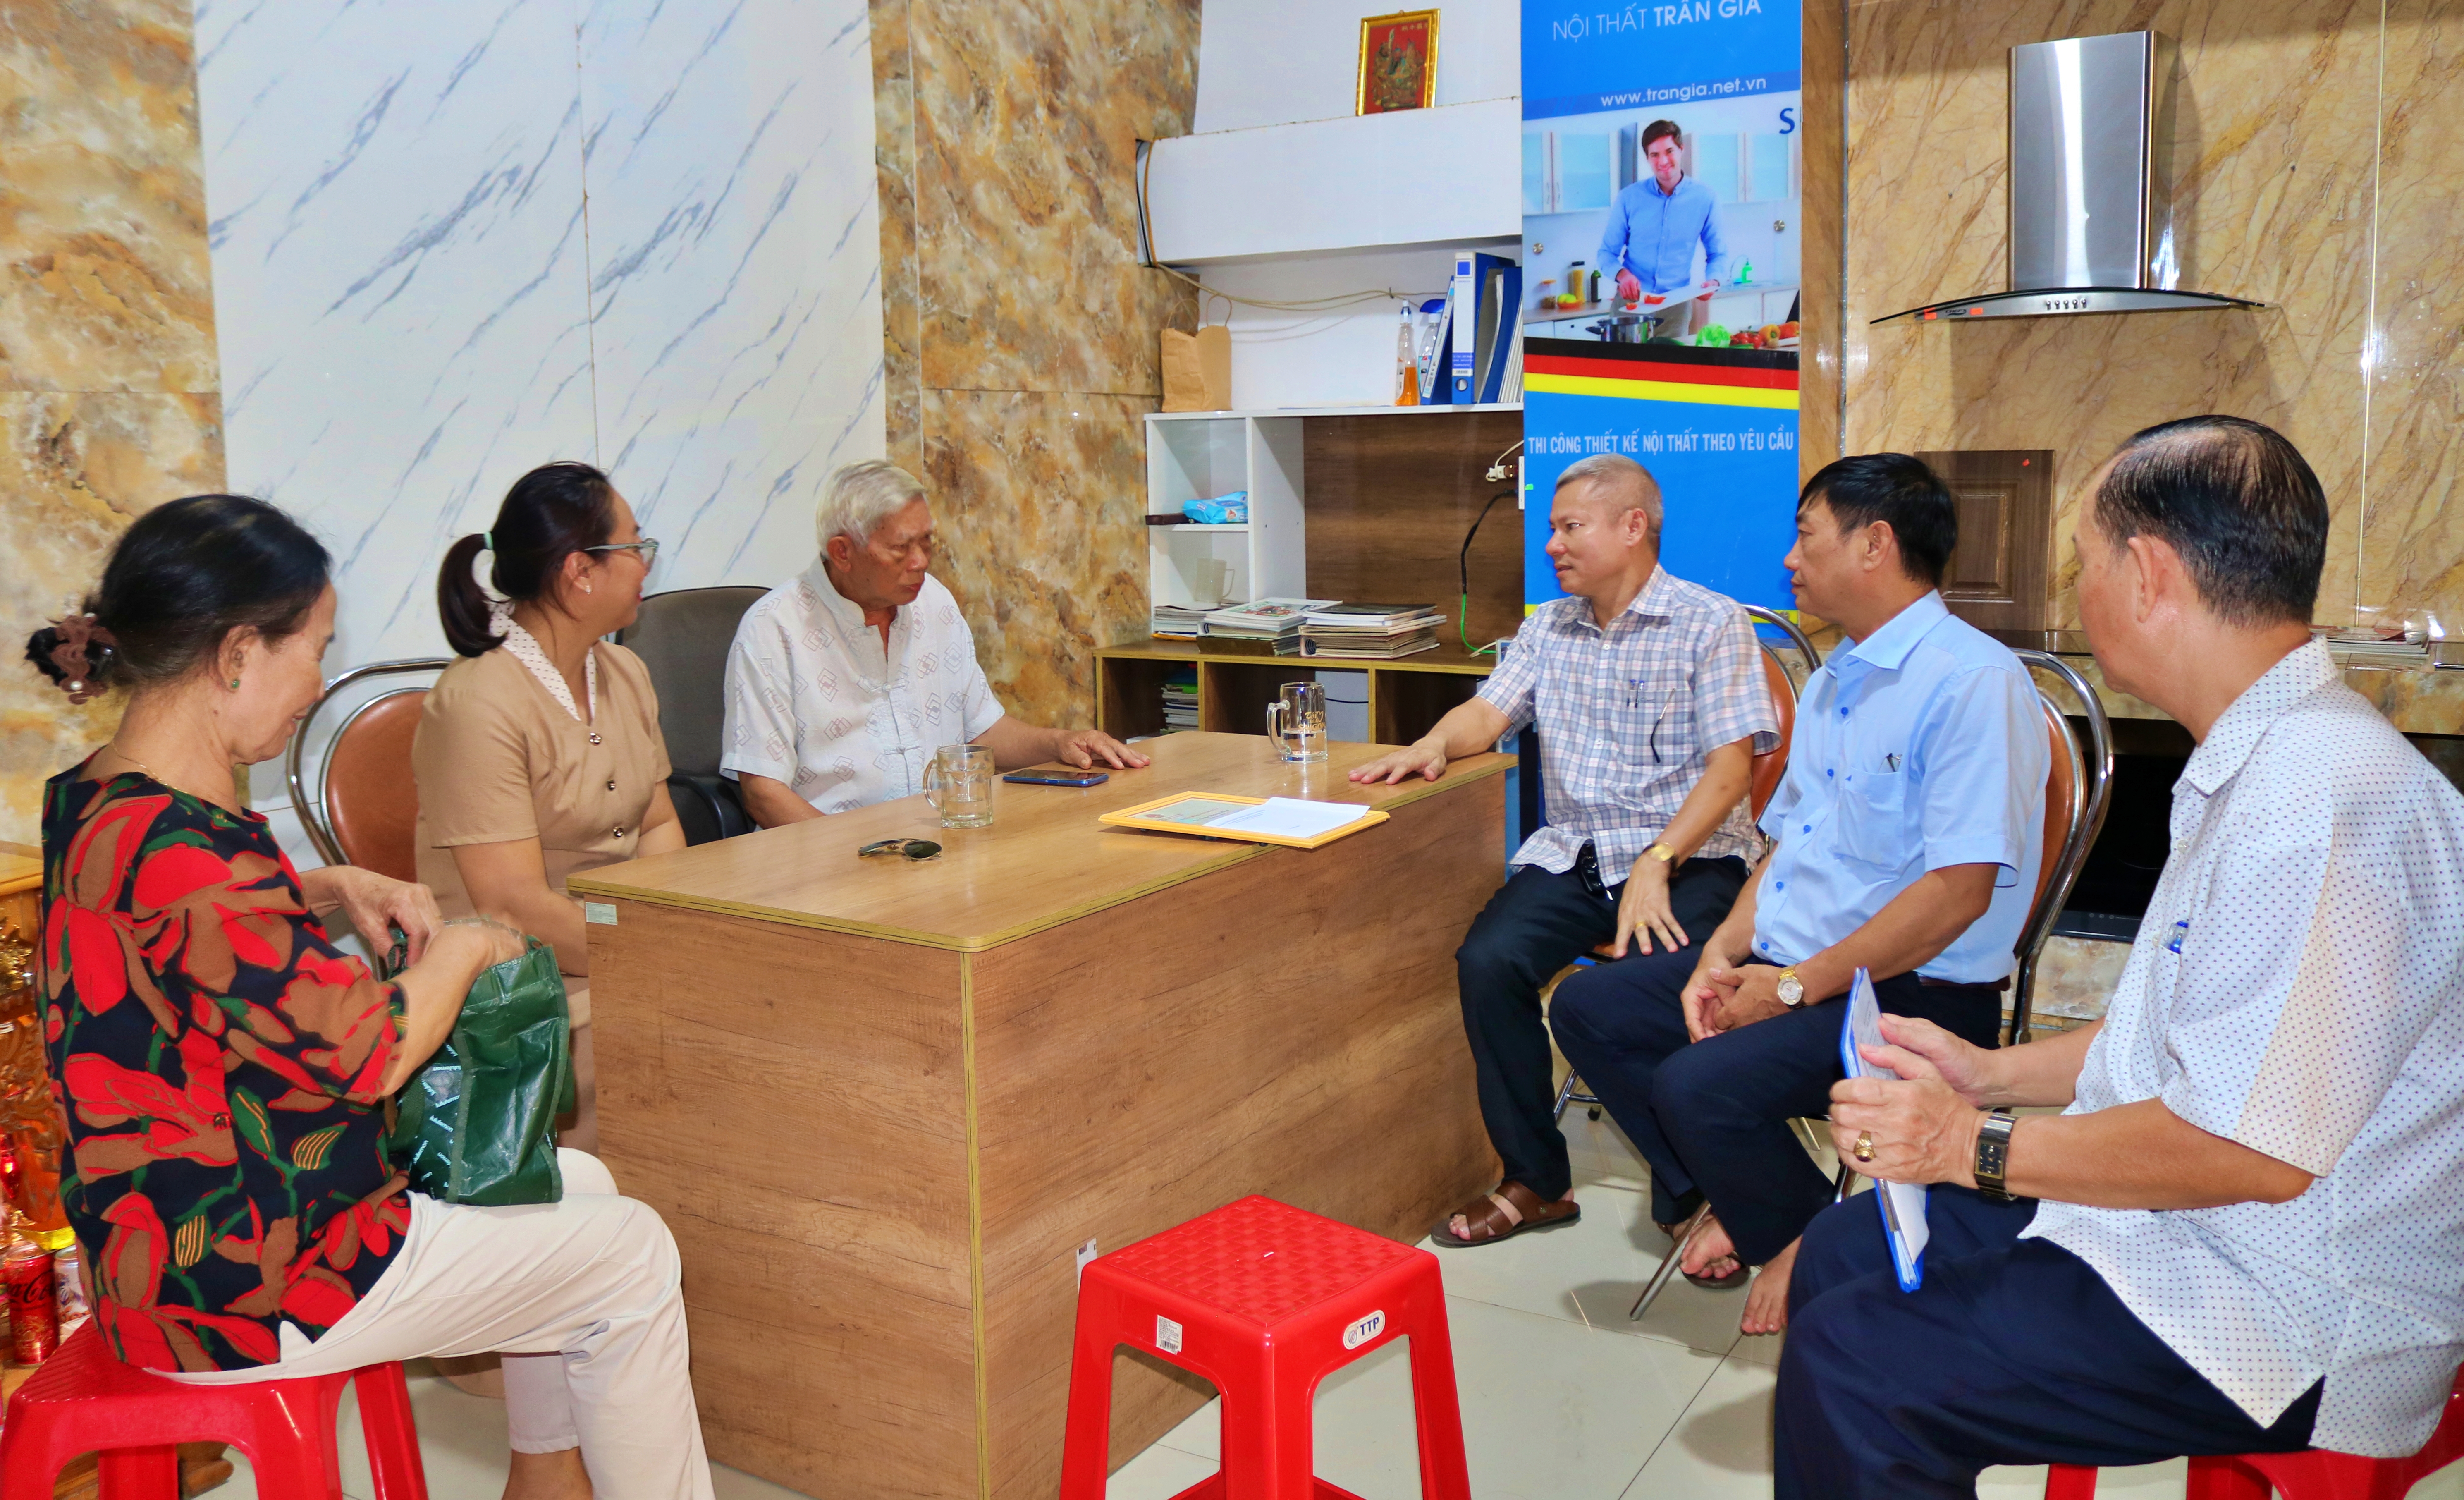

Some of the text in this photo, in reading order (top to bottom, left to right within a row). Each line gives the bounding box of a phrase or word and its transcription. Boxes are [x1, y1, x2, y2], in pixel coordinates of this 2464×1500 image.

[1553, 13, 1589, 43] NỘI
[1596, 2, 1647, 34] THẤT
[1718, 0, 1762, 18] GIA
[1601, 78, 1766, 107] www.trangia.net.vn
[1528, 424, 1794, 455] THI CÔNG THIẾT KẾ NỘI THẤT THEO YÊU CẦU
[435, 1094, 460, 1108] lululemo
[429, 1115, 454, 1132] lululemon
[1360, 1316, 1379, 1336] TTP
